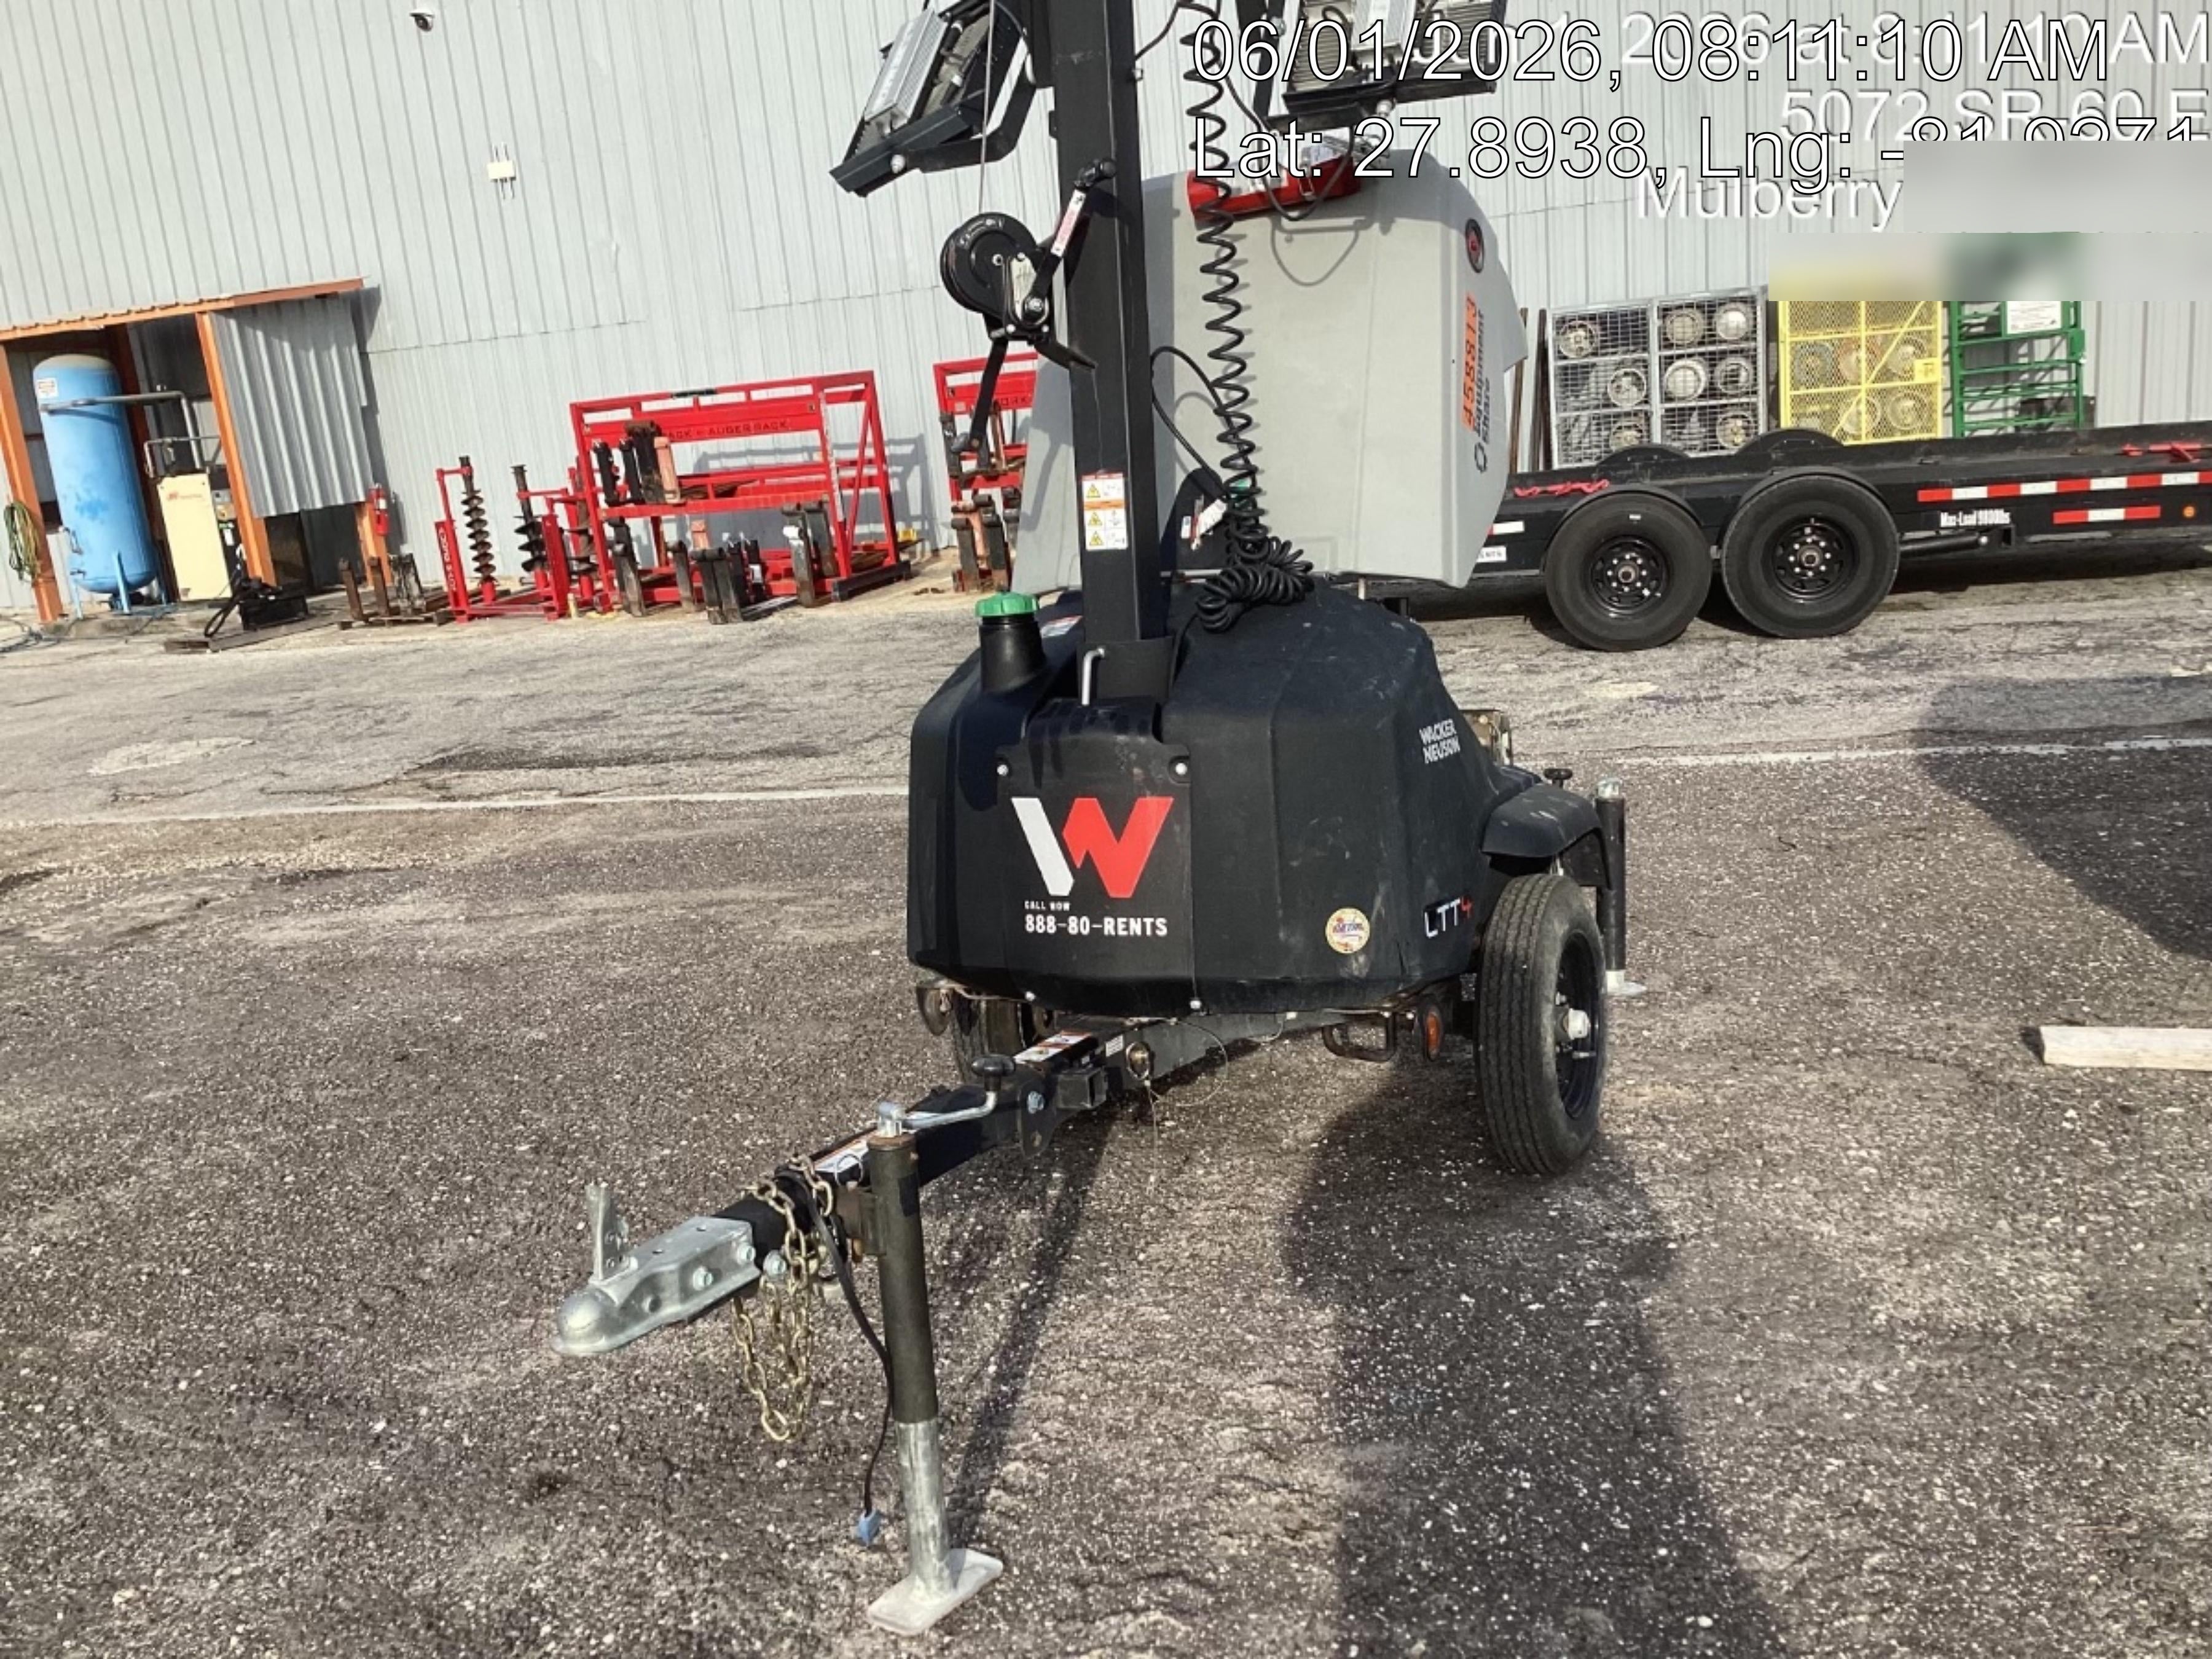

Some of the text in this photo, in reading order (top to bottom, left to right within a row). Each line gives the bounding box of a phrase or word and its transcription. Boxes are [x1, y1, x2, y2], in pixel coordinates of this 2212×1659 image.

[1419, 718, 1457, 745] WACKER
[1422, 735, 1461, 764] NEUSON
[1024, 901, 1070, 911] CALL NOW
[1025, 914, 1168, 936] 888-80-RENTS
